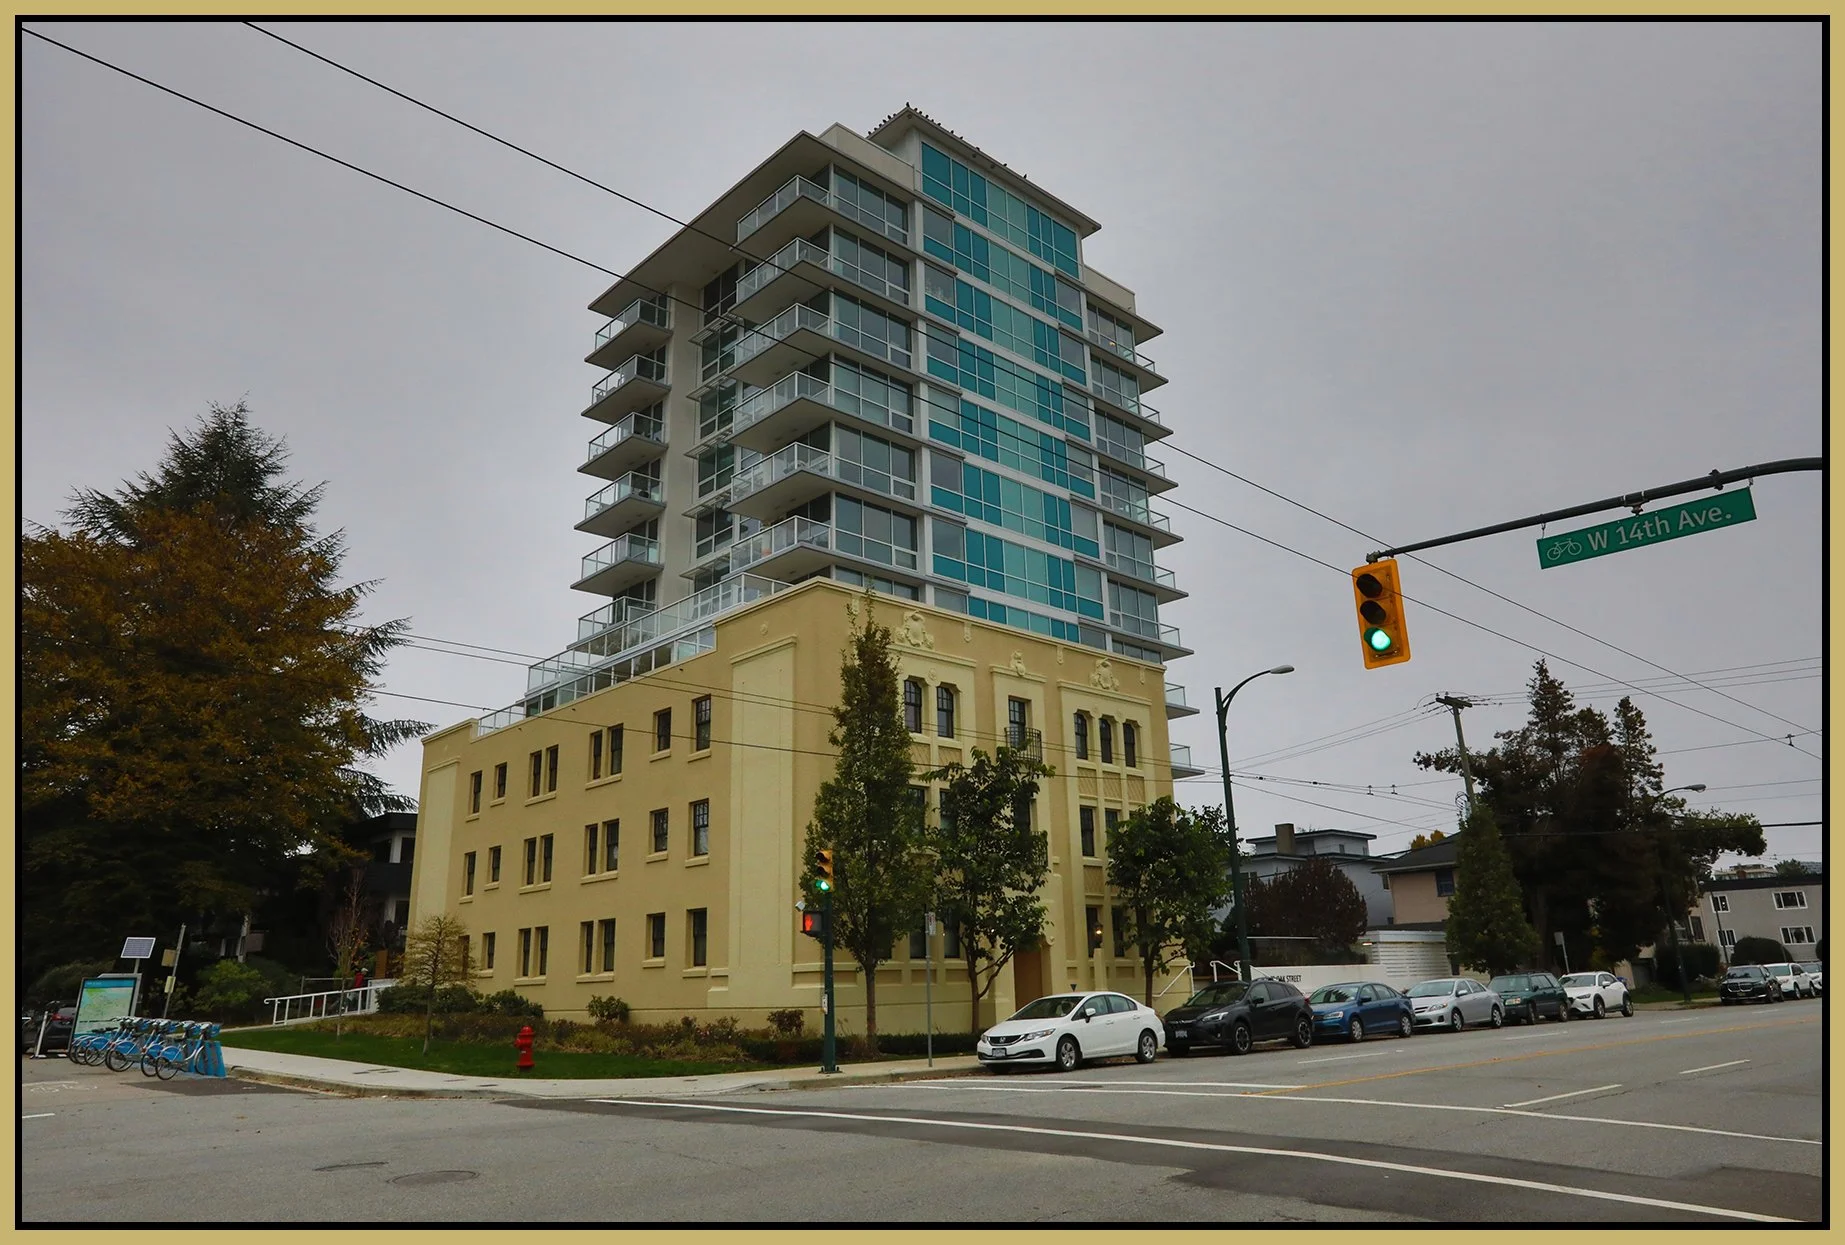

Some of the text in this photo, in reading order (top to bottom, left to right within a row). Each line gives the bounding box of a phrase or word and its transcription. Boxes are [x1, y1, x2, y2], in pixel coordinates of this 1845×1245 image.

[1588, 506, 1732, 551] W 14th Ave.
[1286, 974, 1302, 983] STREET
